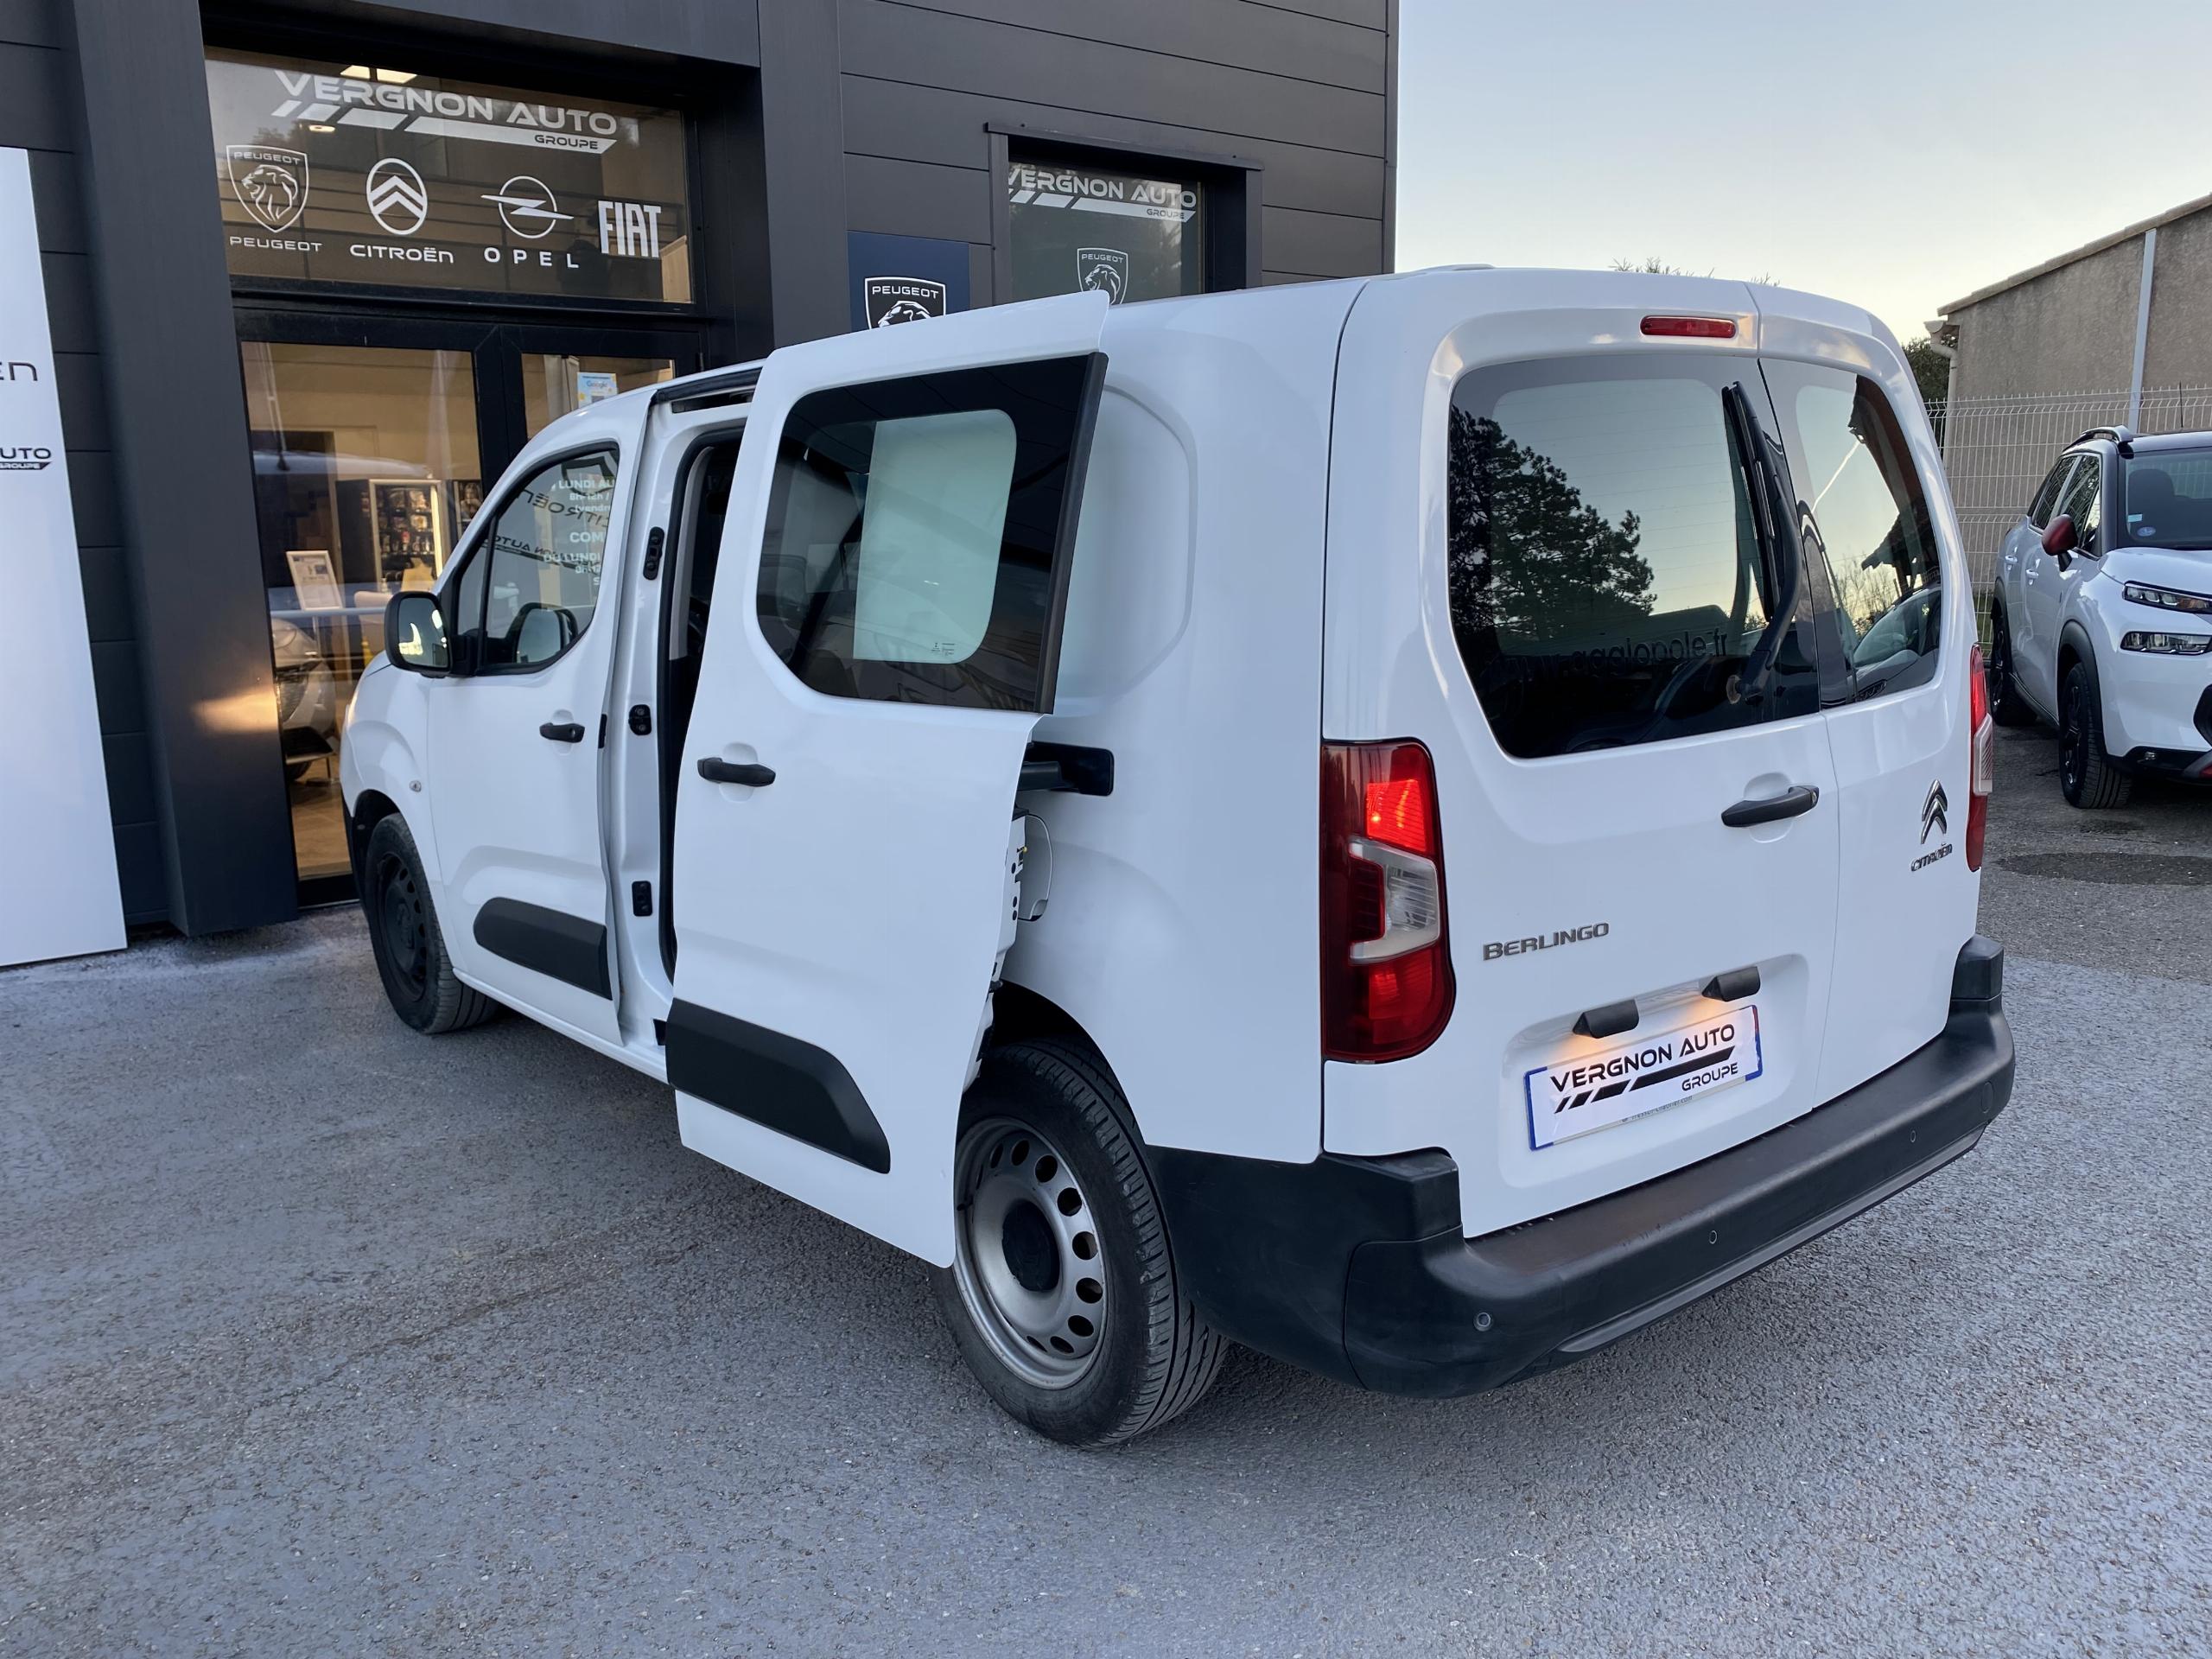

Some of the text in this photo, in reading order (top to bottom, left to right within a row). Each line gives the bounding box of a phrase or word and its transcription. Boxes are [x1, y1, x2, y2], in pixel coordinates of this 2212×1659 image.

[274, 70, 619, 136] VERGNON AUTO
[534, 134, 598, 150] GROUPE
[233, 150, 301, 165] PEUGEOT
[1131, 180, 1198, 208] AUTO
[1147, 208, 1185, 219] GROUPE
[597, 200, 662, 257] FIAT
[229, 236, 323, 252] PEUGEOT
[484, 247, 580, 269] OPEL
[1081, 253, 1124, 264] PEUGEOT
[872, 285, 939, 300] PEUGEOT
[1482, 921, 1610, 962] BERLINGO
[1549, 1023, 1736, 1094] VERGNON AUTO
[1681, 1062, 1739, 1092] GROUPE
